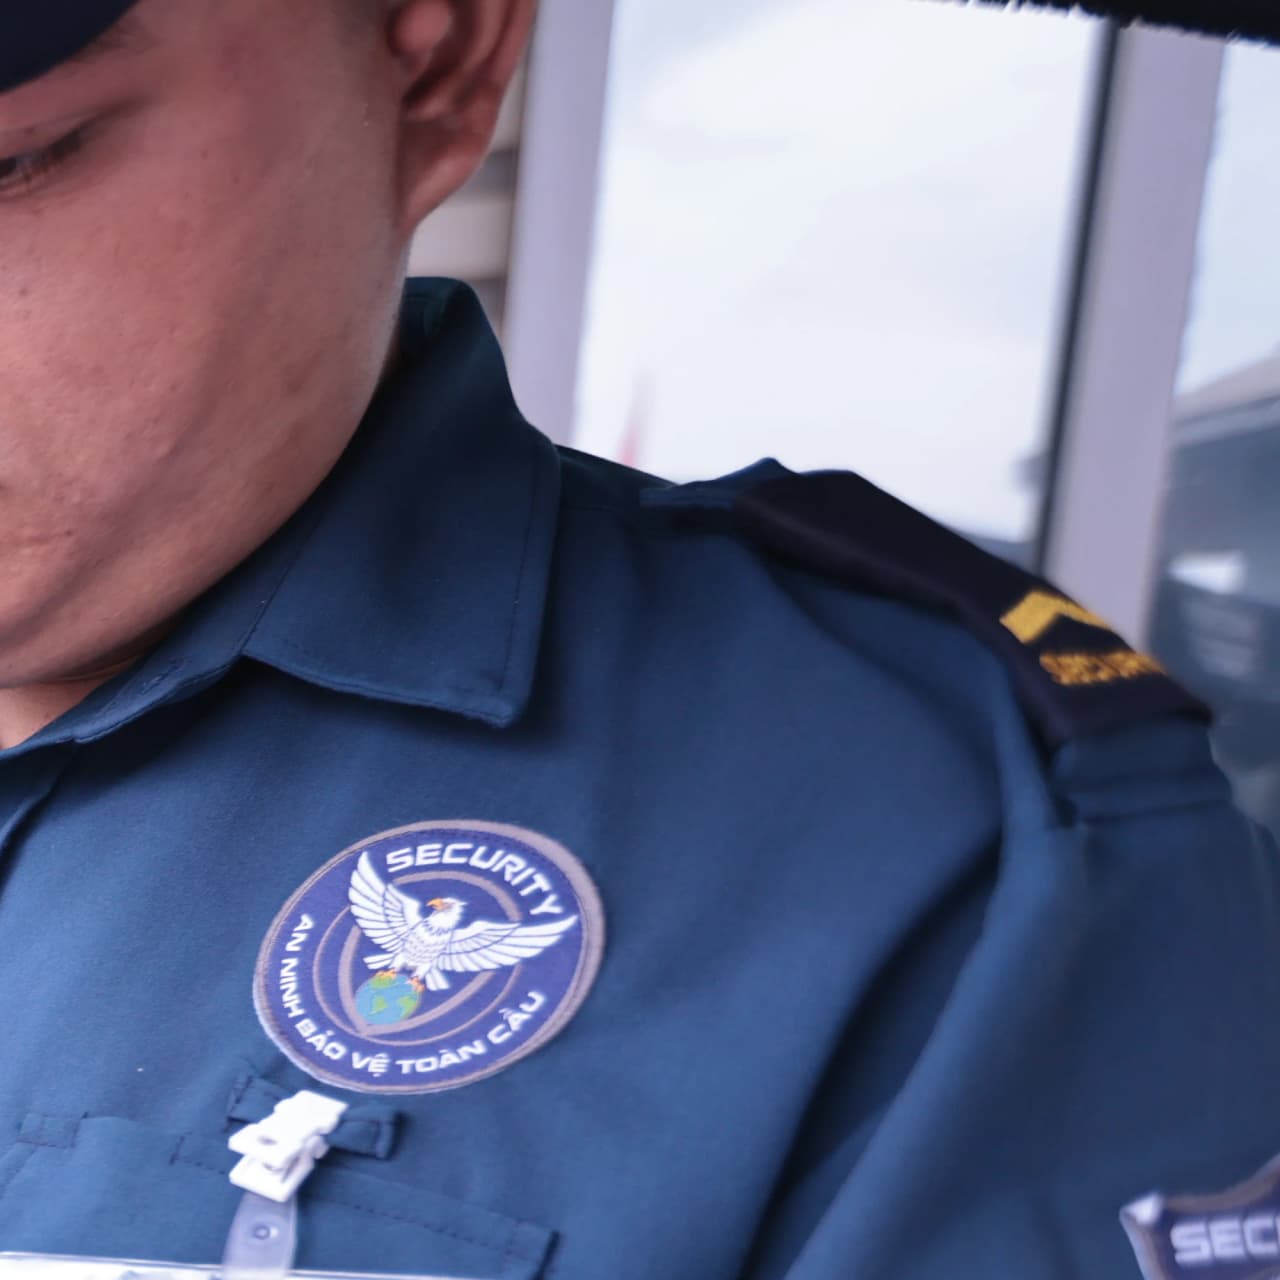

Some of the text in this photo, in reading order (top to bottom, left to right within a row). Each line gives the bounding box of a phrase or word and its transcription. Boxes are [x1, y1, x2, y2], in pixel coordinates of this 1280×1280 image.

[385, 842, 563, 916] SECURITY
[279, 913, 547, 1077] AN NINH BẢO VỆ TOÀN CẦU
[1170, 1213, 1280, 1267] SEC
